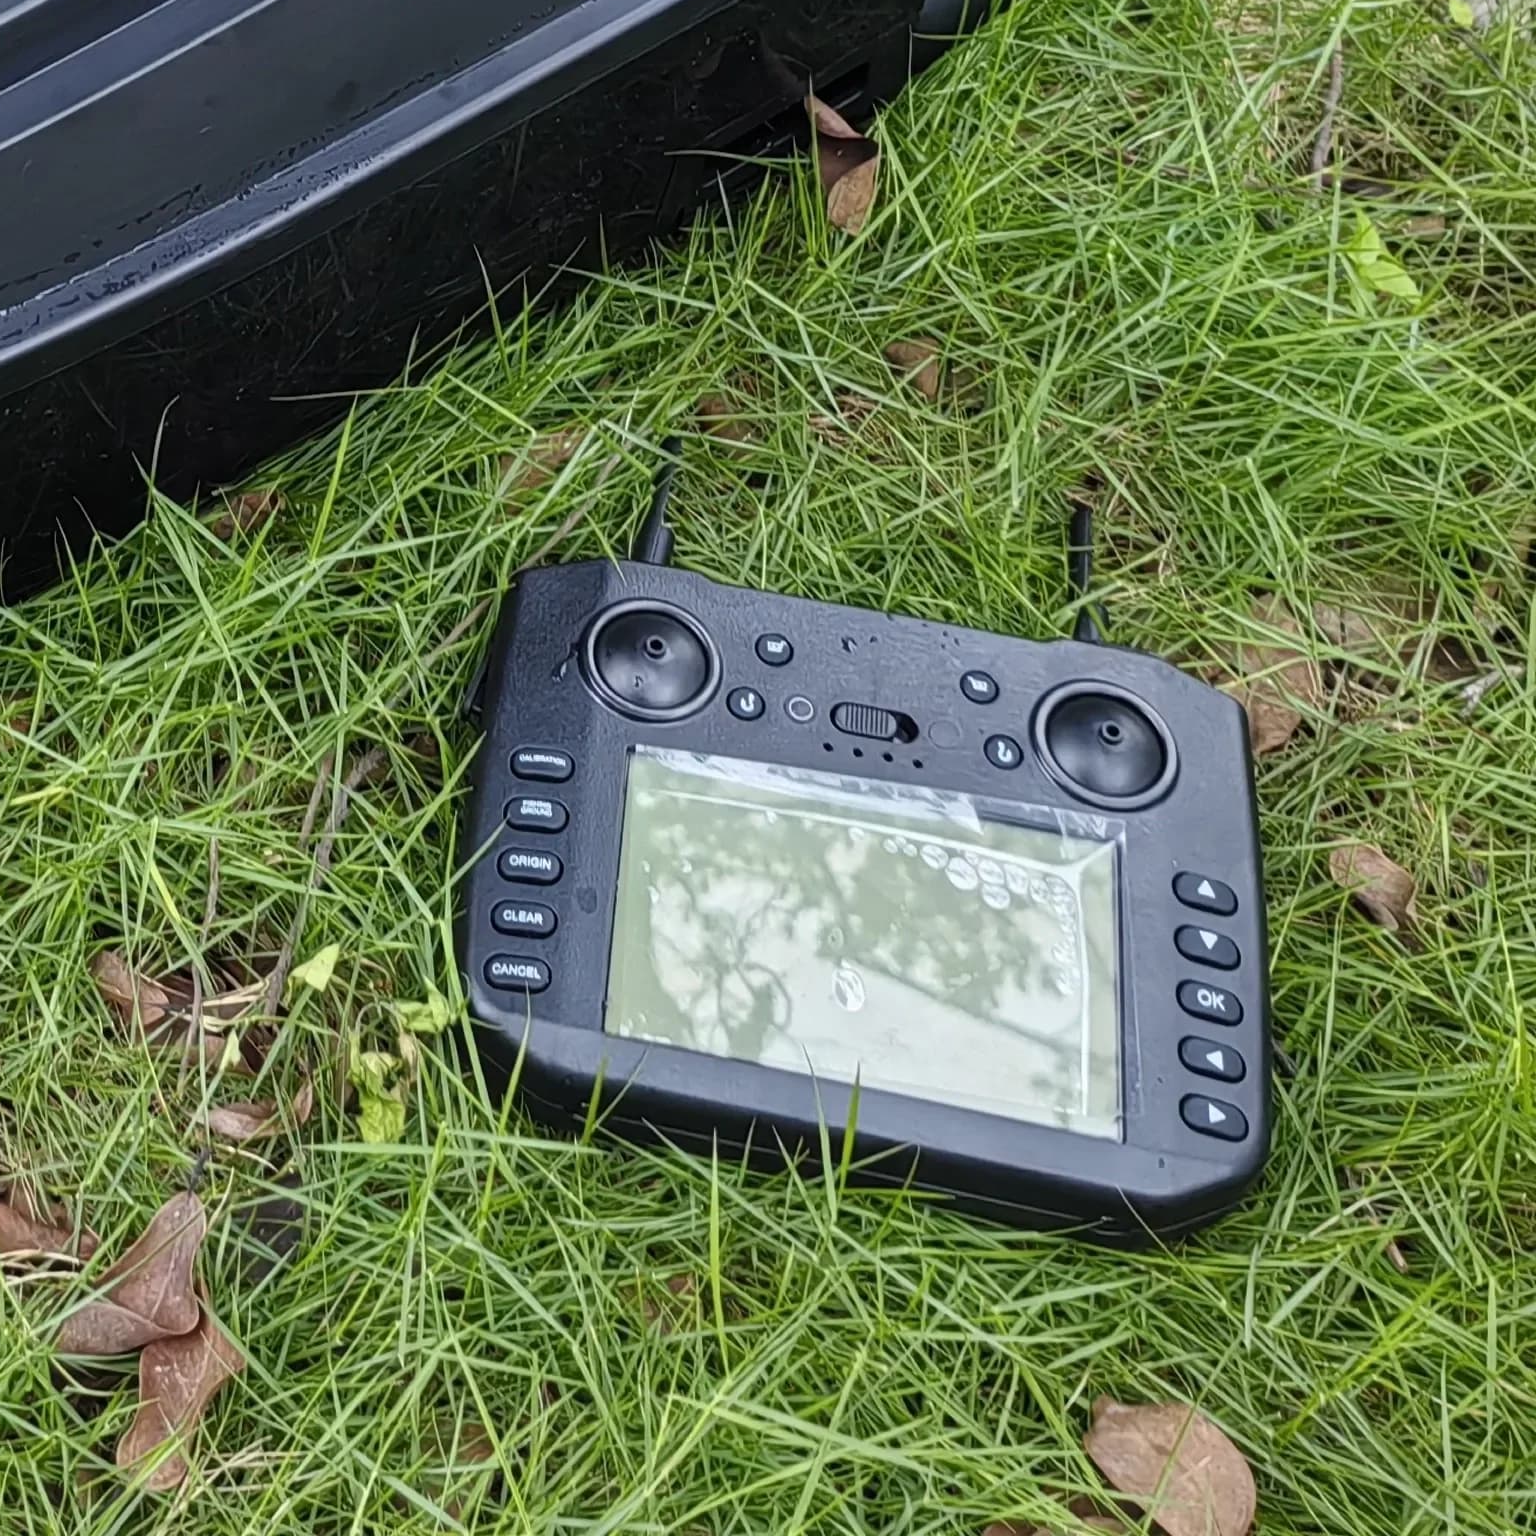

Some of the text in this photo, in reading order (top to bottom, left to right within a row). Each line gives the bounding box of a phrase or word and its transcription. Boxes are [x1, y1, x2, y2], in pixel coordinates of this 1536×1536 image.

[508, 854, 552, 871] ORIGIN
[502, 909, 544, 926] CLEAR
[491, 962, 542, 980] CANCEL
[1196, 988, 1227, 1012] OK
